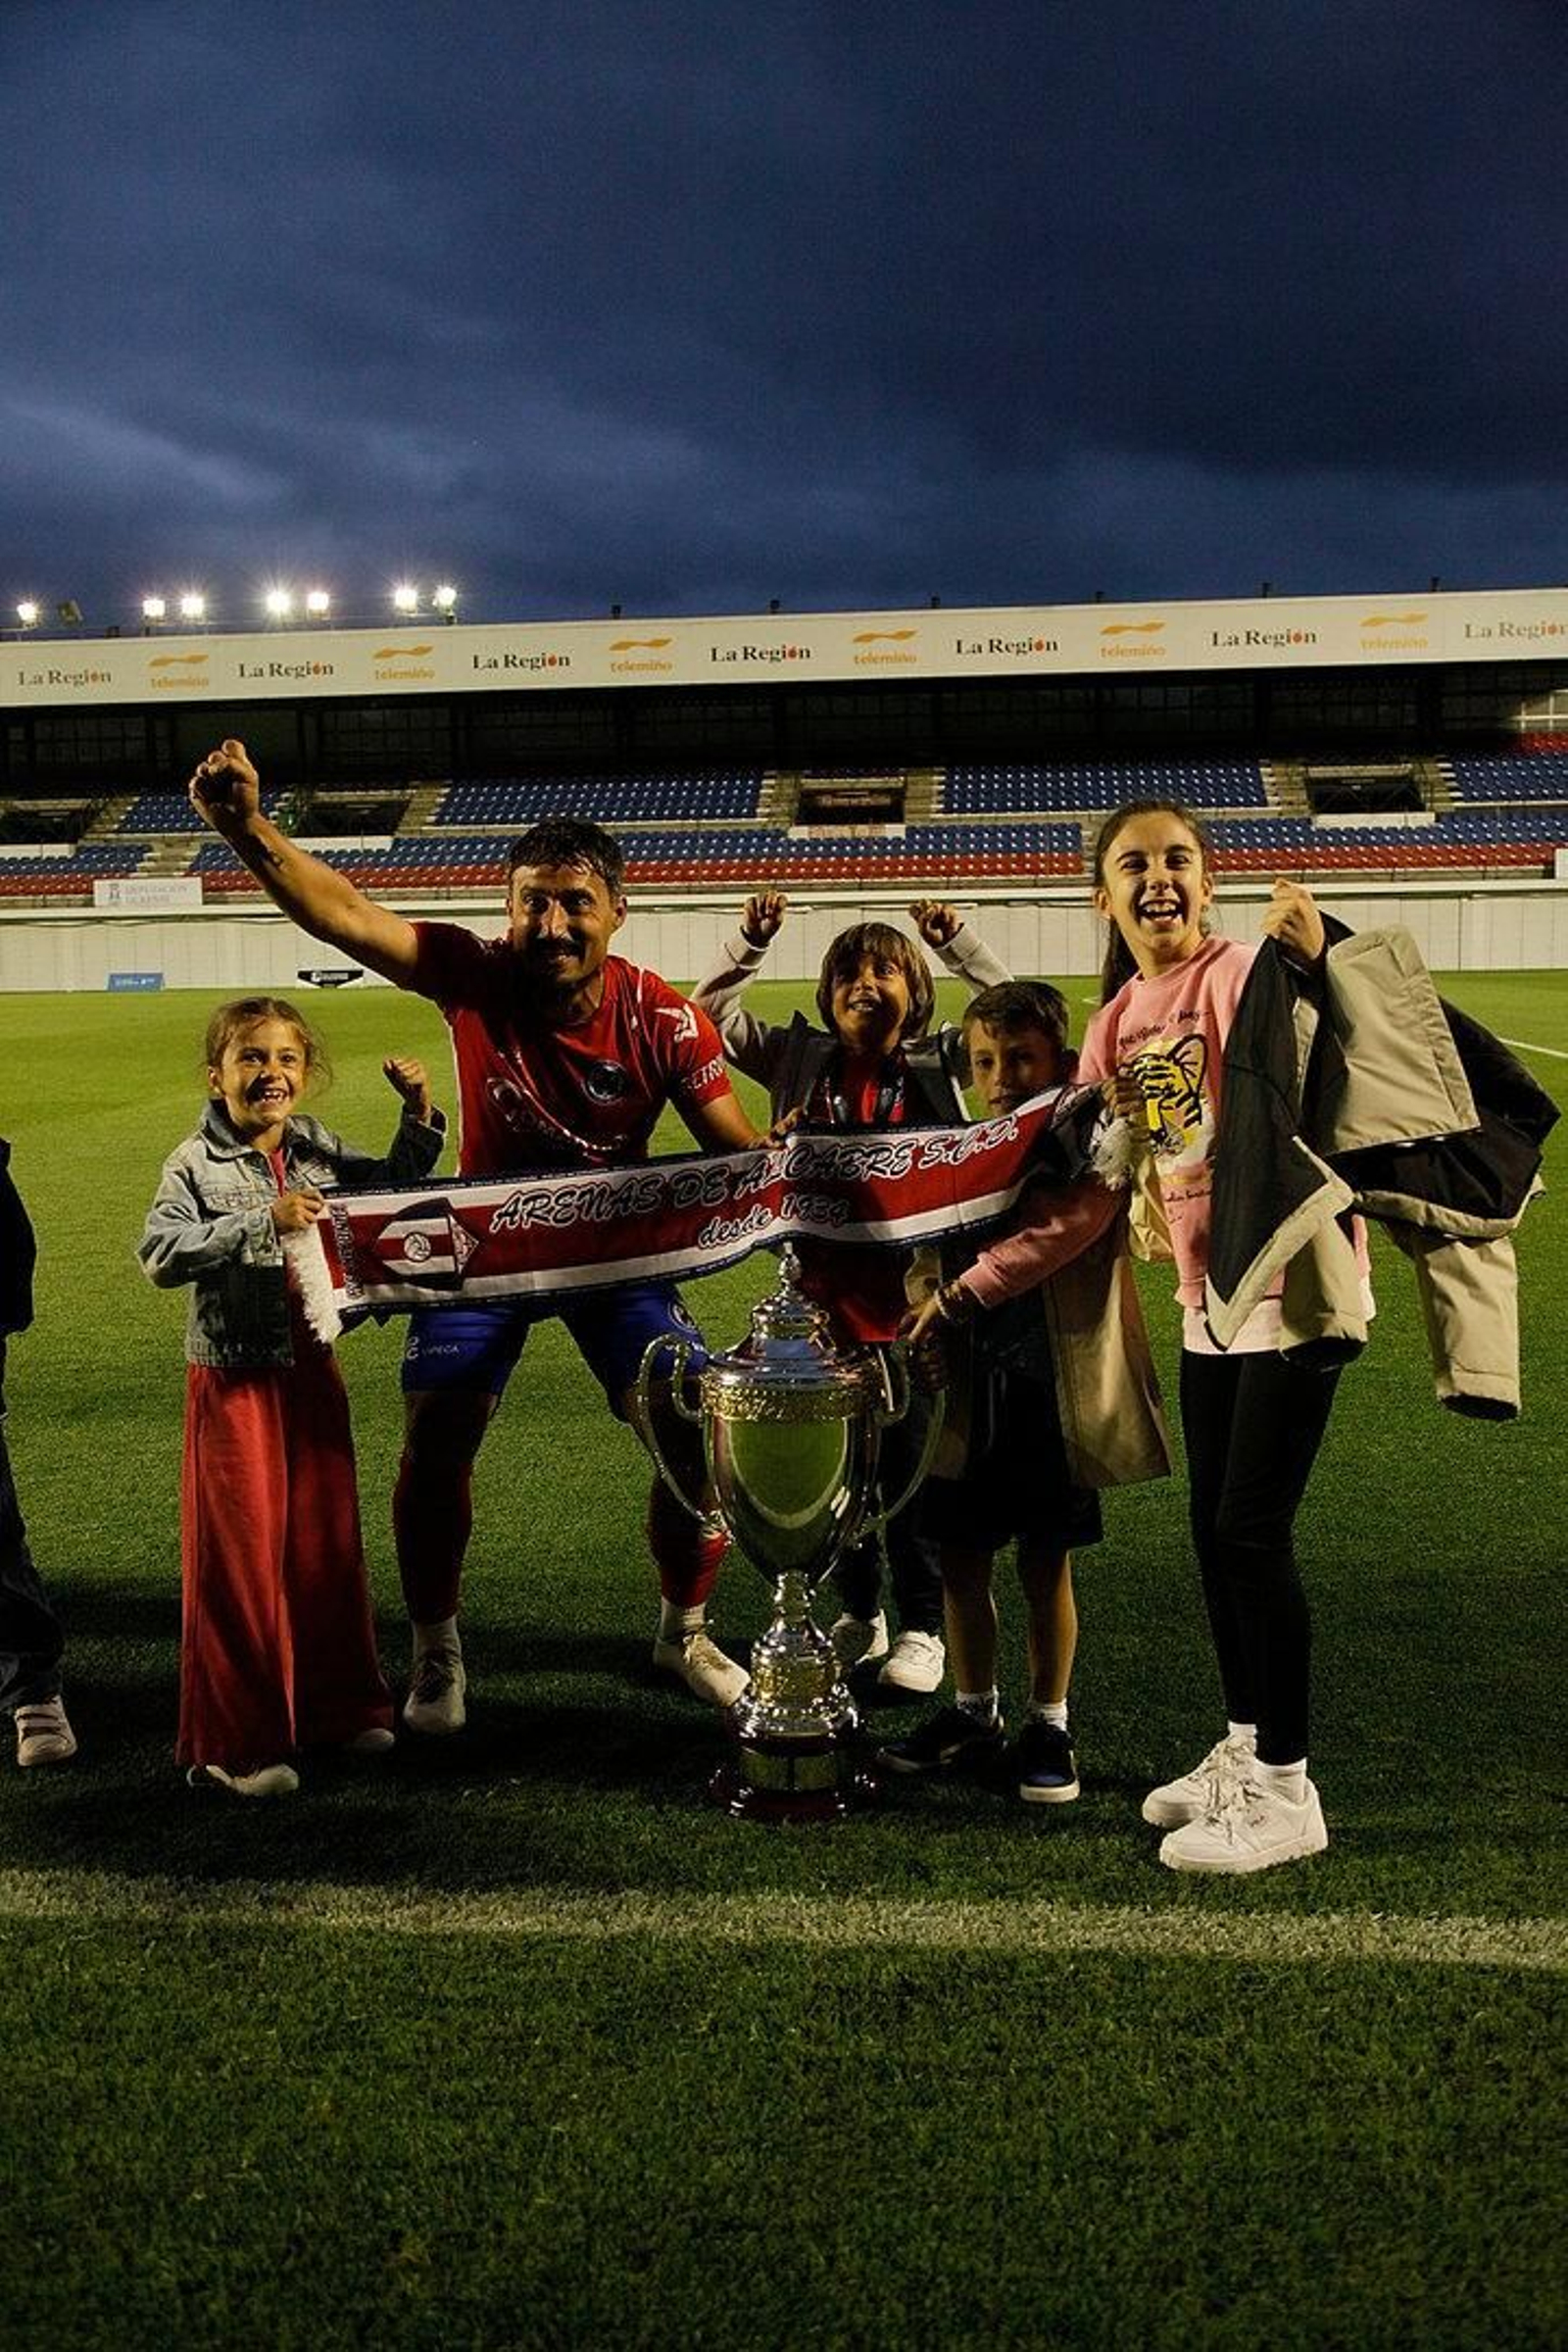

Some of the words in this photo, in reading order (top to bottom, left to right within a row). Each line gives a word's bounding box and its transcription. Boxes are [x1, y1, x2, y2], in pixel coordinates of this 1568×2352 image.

[1465, 623, 1492, 638] La
[956, 639, 983, 655] La
[1213, 631, 1239, 647] La
[472, 654, 499, 669] La
[710, 647, 737, 662] La
[19, 670, 44, 686] La
[238, 662, 265, 678] La
[490, 1174, 665, 1234] ARENAS
[671, 1164, 732, 1208] DE
[698, 1203, 773, 1249] desde
